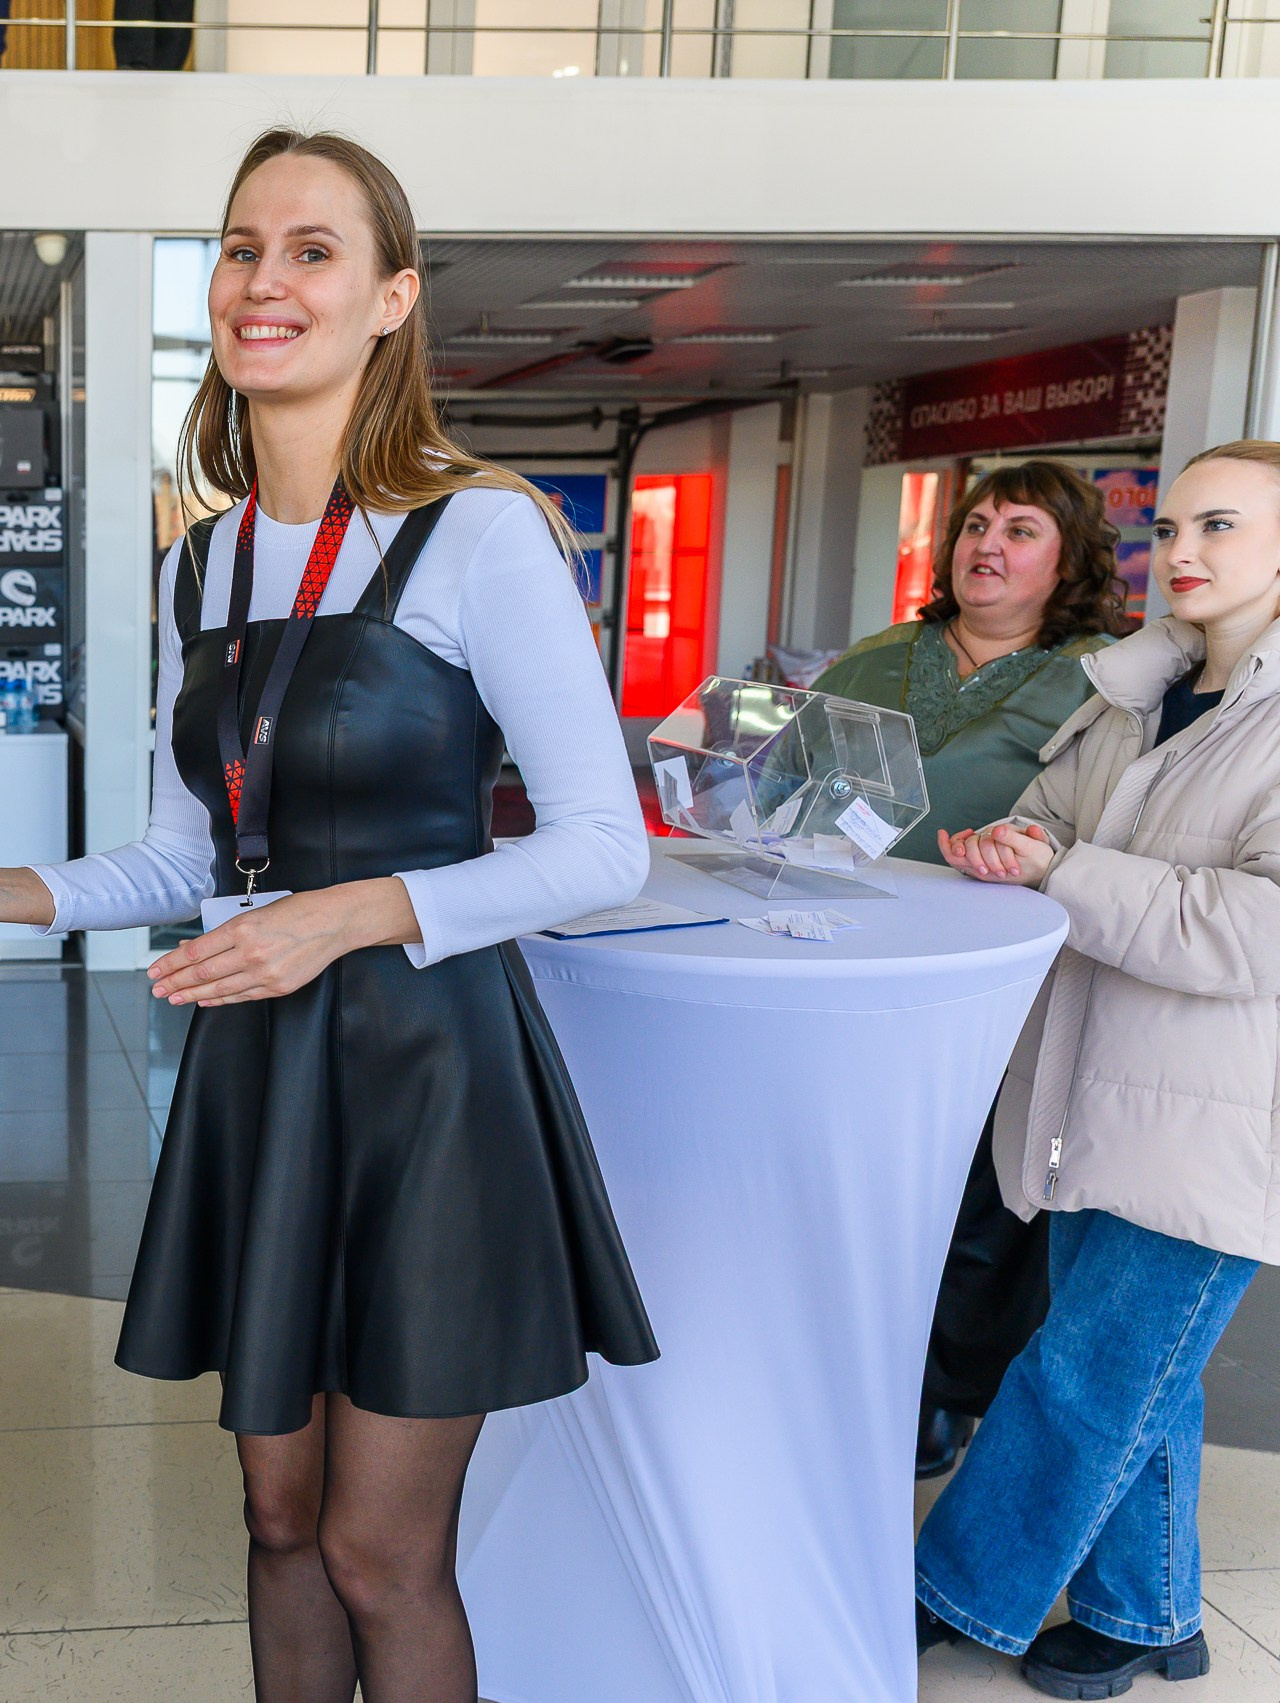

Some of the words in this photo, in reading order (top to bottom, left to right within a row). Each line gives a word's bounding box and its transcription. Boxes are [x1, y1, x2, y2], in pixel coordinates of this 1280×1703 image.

[909, 397, 978, 429] СПАСИБО
[979, 394, 1000, 419] ЗА
[1002, 386, 1042, 416] ВАШ
[1045, 374, 1115, 409] ВЫБОР!
[258, 718, 269, 743] AVS
